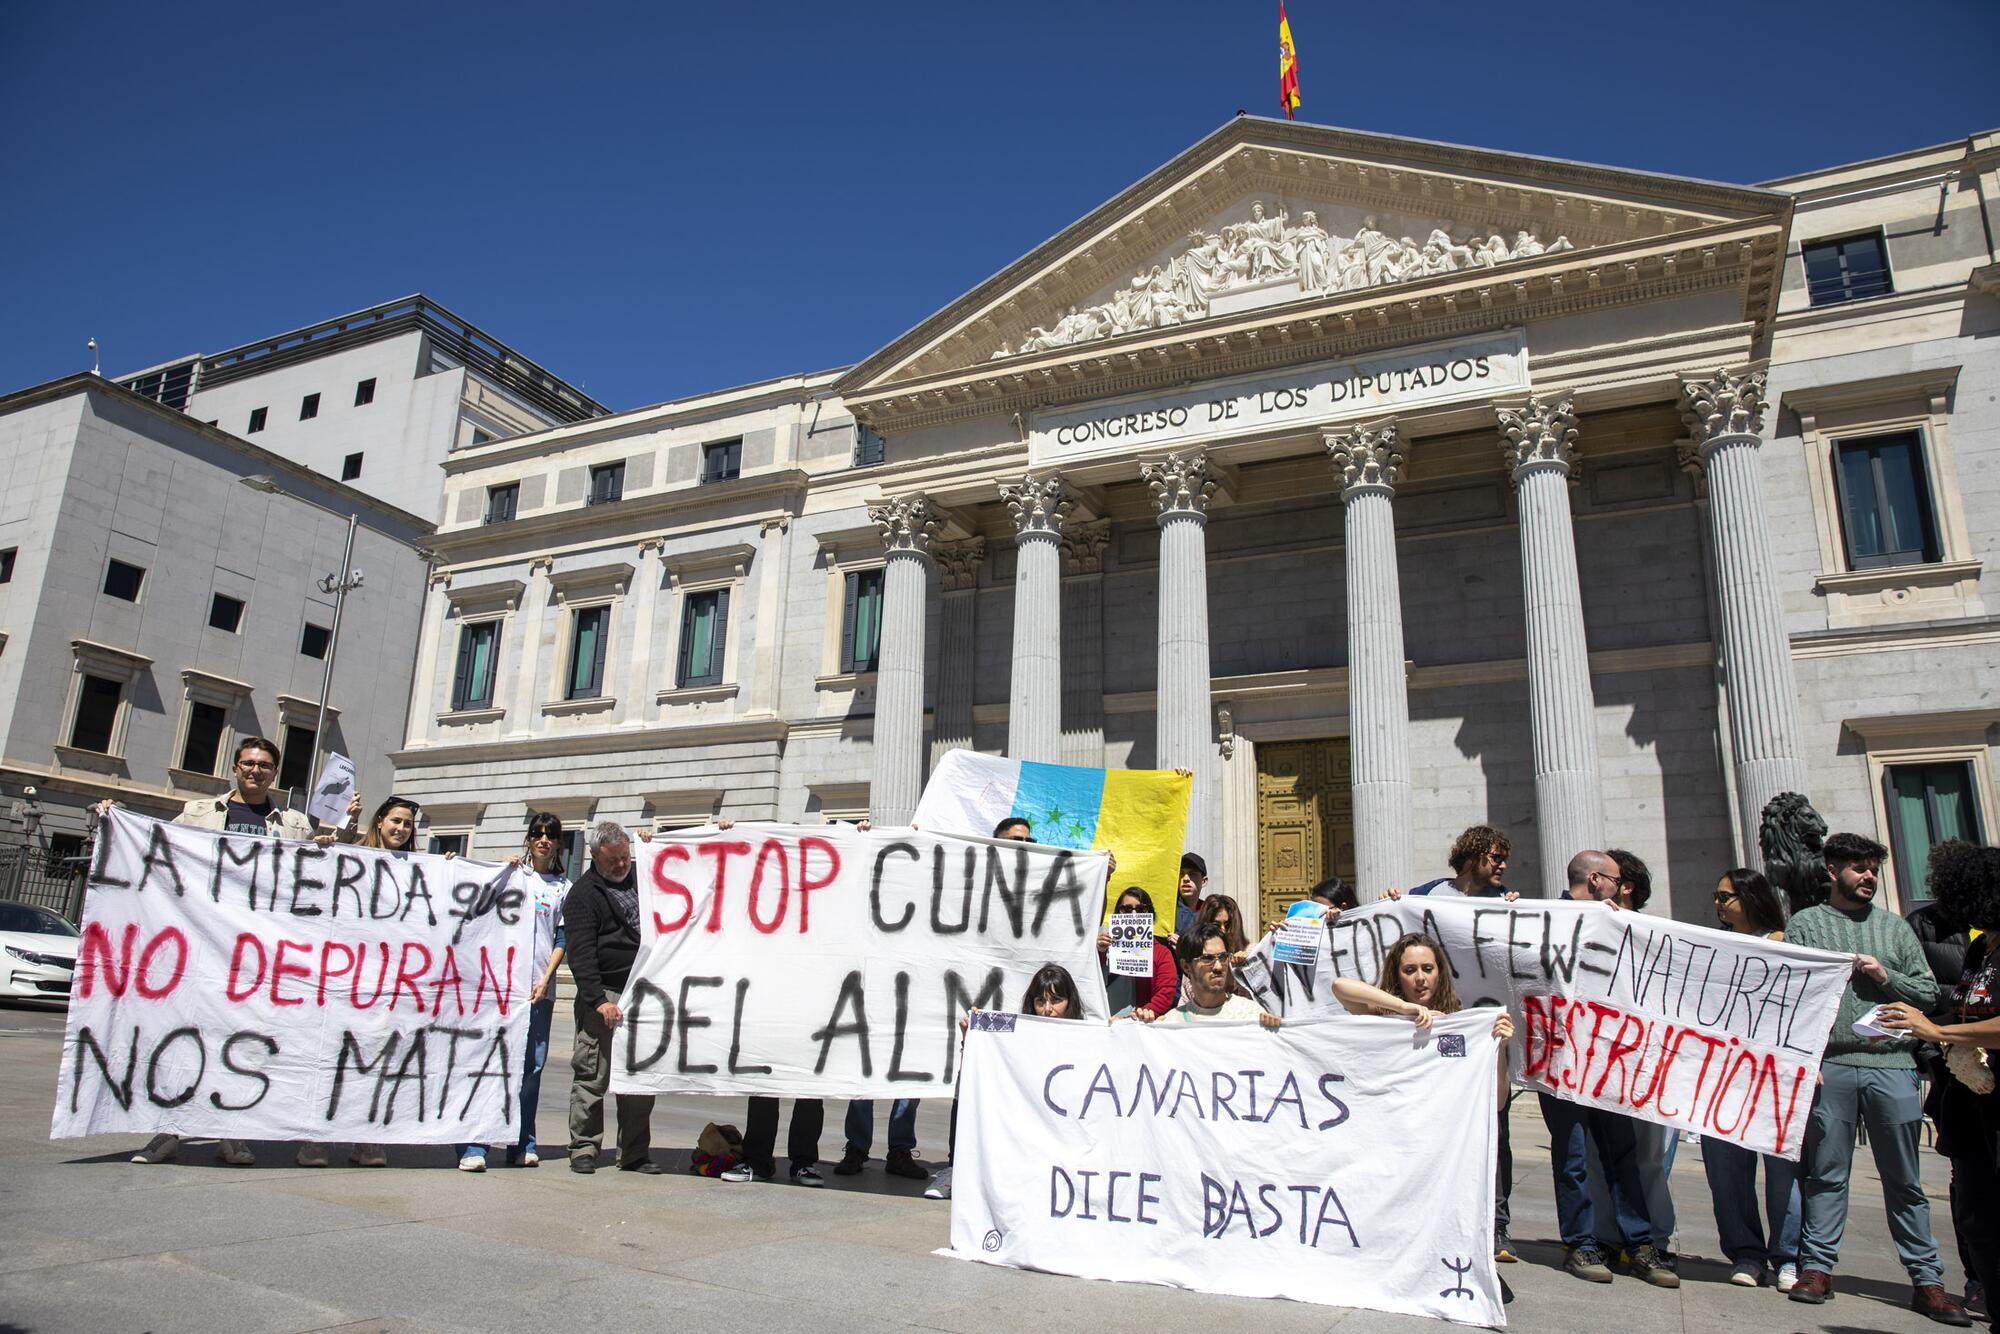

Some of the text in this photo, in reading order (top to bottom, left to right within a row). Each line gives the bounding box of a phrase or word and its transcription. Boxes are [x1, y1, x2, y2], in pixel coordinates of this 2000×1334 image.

[1057, 356, 1490, 446] CONGRESO DE LOS DIPUTADOS
[88, 810, 184, 897] LA
[211, 837, 437, 926] MIERDA
[652, 836, 1088, 938] STOP CUNA
[78, 921, 516, 1018] NO DEPURAN
[1112, 926, 1152, 940] 90%
[625, 966, 1005, 1084] DEL ALM
[1607, 924, 1813, 1054] NATURAL
[71, 1025, 512, 1126] NOS MATA
[1044, 1063, 1350, 1132] CANARIAS
[1050, 1165, 1361, 1248] DICE BASTA
